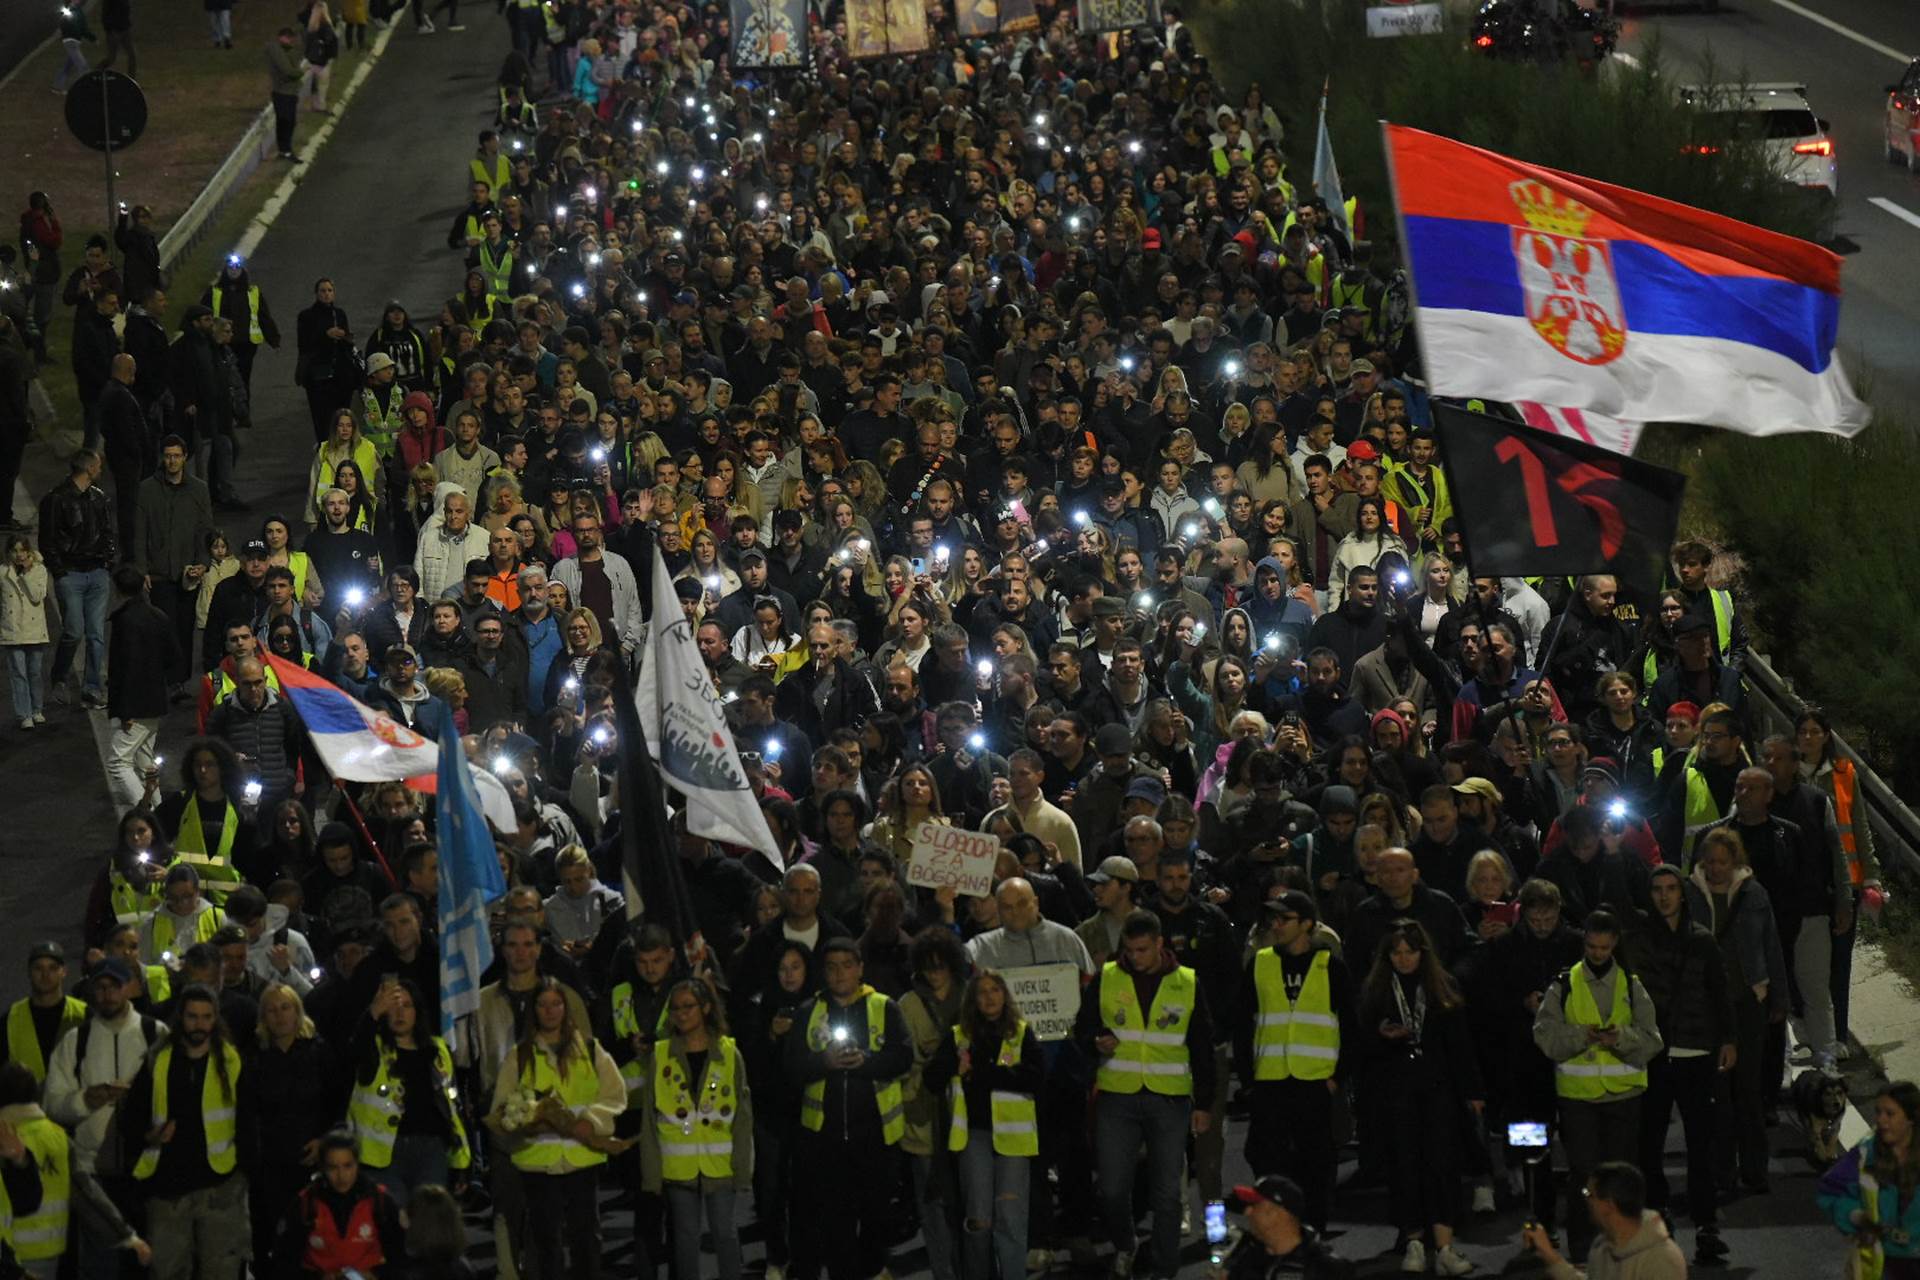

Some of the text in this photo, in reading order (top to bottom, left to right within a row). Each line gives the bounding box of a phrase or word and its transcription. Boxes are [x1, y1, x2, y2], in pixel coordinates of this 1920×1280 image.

[919, 826, 995, 860] SLOBODA
[929, 848, 964, 867] ZA
[911, 864, 989, 892] BOGDANA
[1014, 980, 1038, 995] UVEK
[1039, 979, 1051, 994] UZ
[1015, 998, 1058, 1015] TUDENTE
